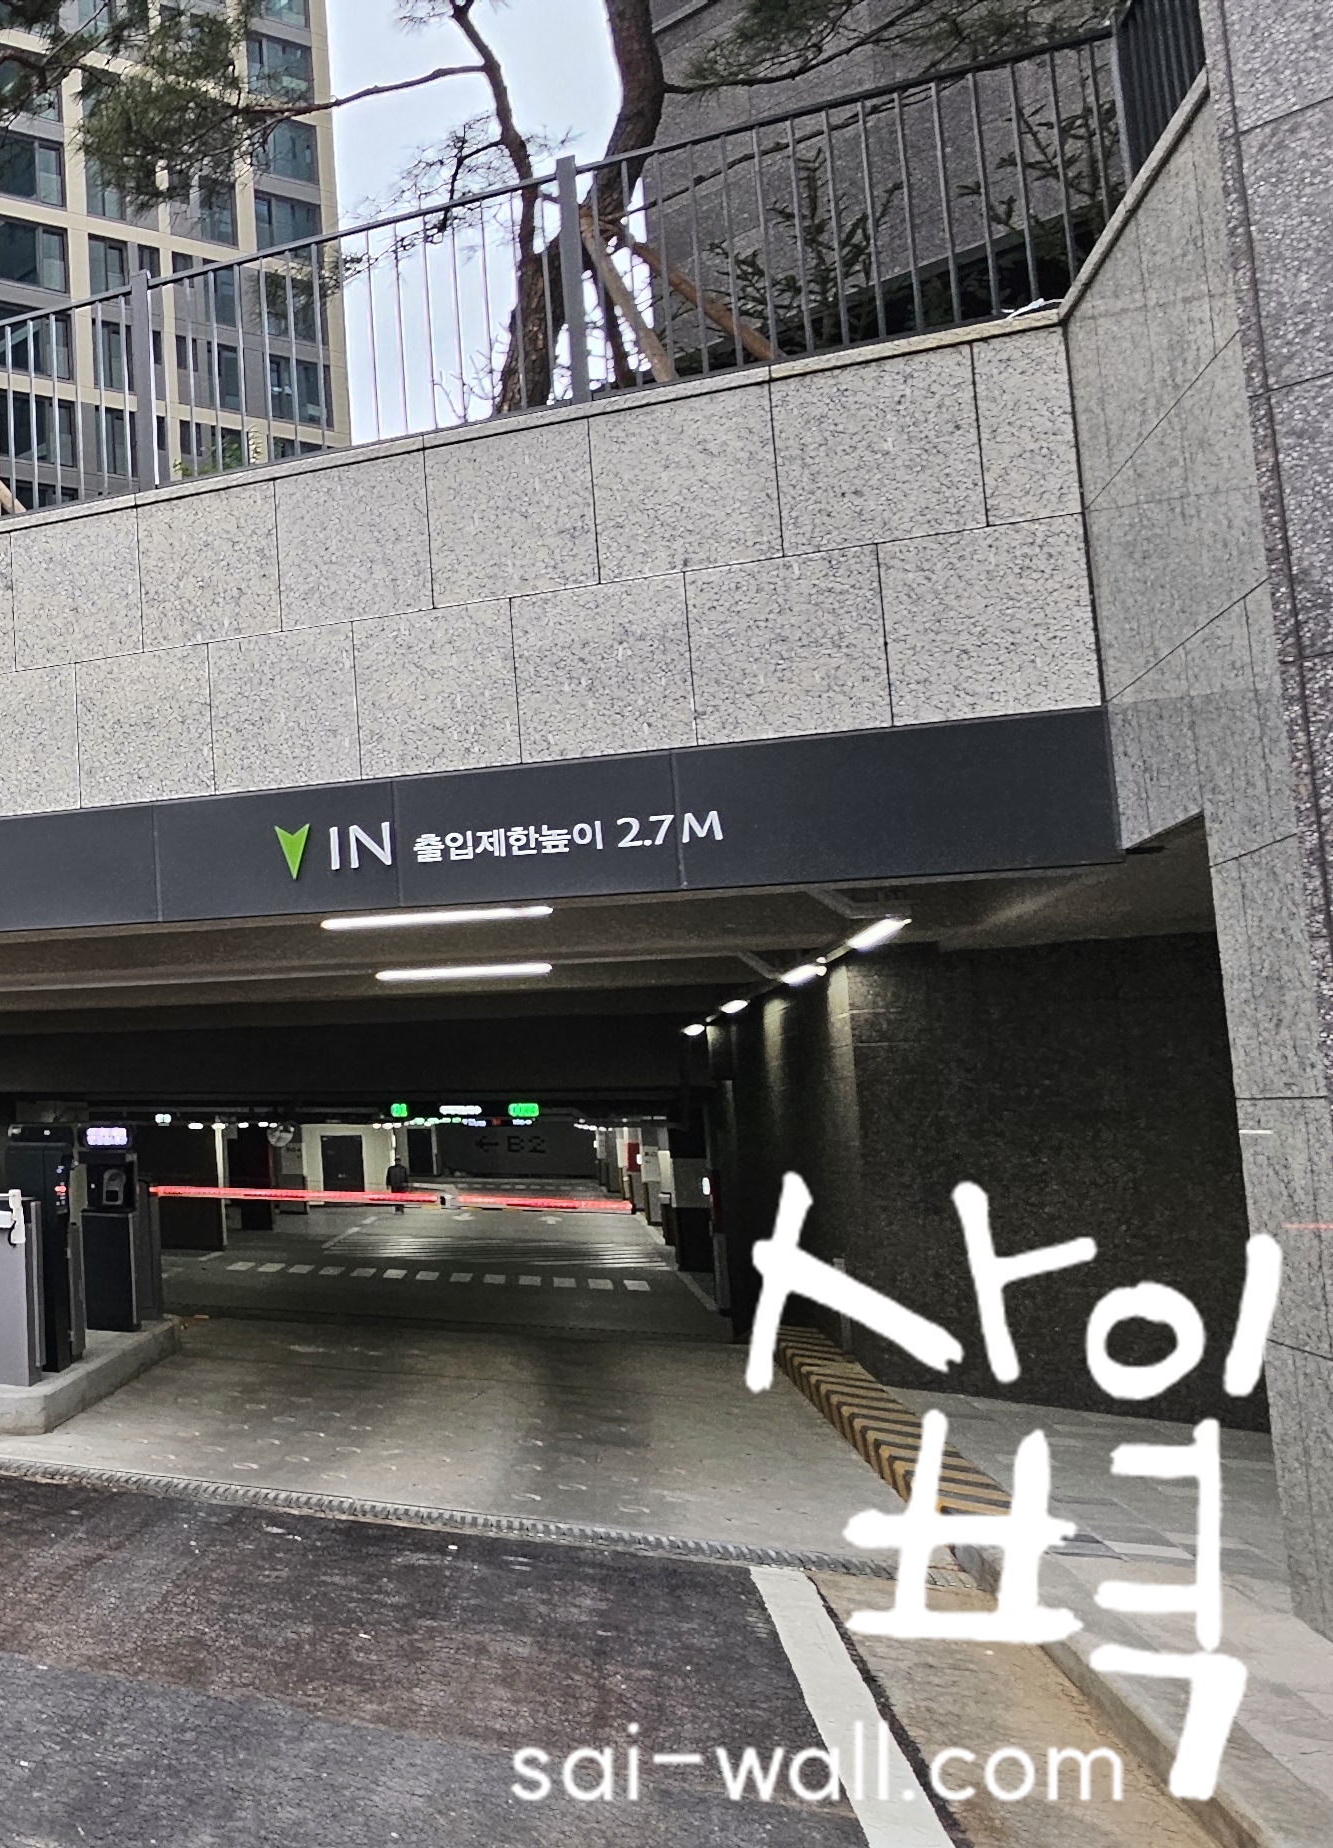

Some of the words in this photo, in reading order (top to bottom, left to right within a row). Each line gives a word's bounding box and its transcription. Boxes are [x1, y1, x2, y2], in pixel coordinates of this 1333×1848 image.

[328, 821, 393, 871] IN
[412, 820, 603, 864] 출입제한높이
[506, 1135, 547, 1154] B2
